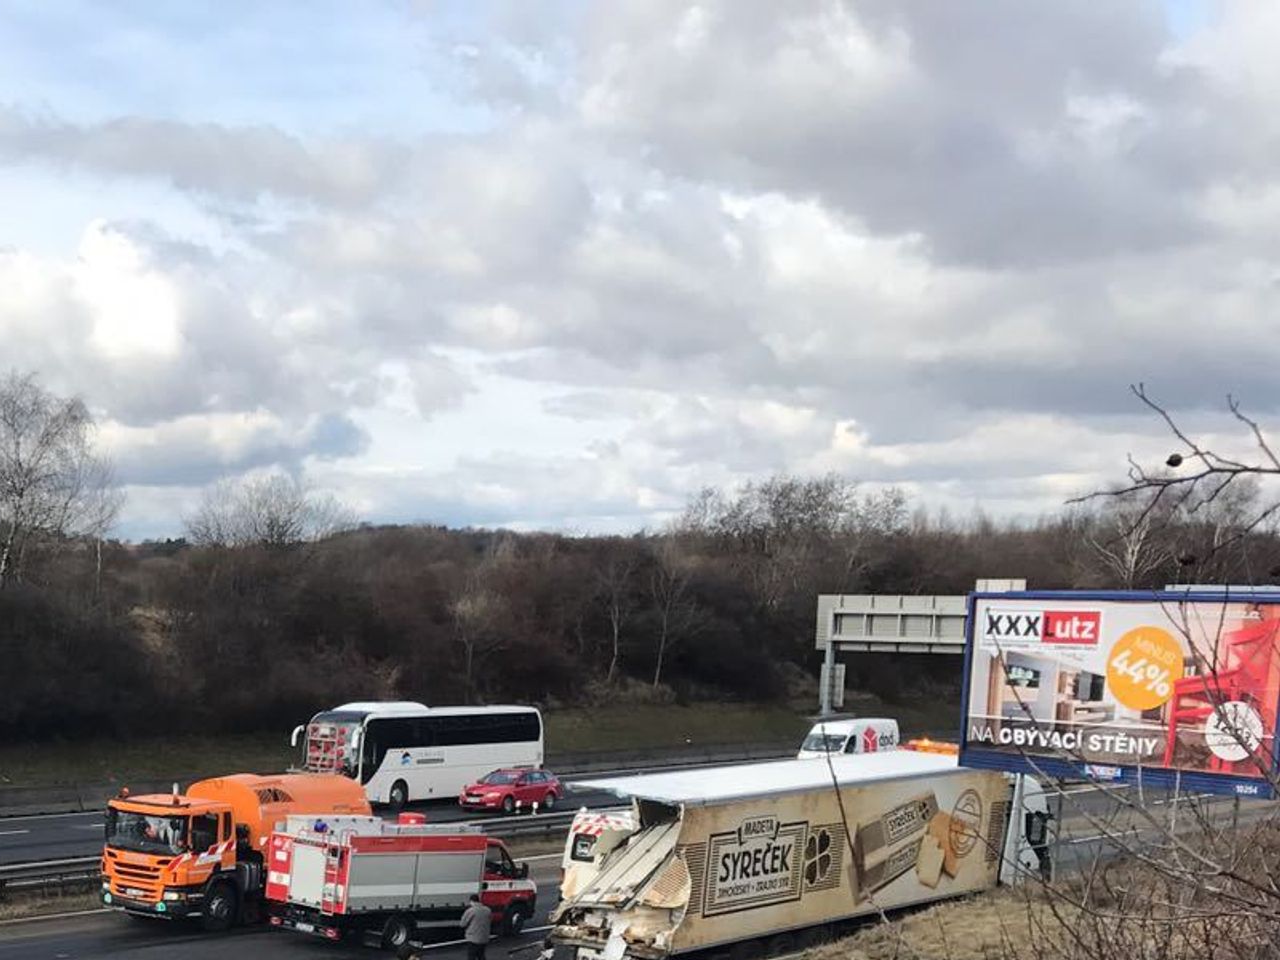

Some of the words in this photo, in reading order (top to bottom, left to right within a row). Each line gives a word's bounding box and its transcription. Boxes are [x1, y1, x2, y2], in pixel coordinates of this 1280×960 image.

[986, 615, 1097, 639] XXXLutz
[1112, 649, 1170, 697] 44%
[879, 730, 894, 747] dpd
[970, 726, 994, 743] NA
[1088, 733, 1158, 756] STĚNY
[744, 819, 775, 835] MADETA
[720, 843, 791, 882] SYREČEK
